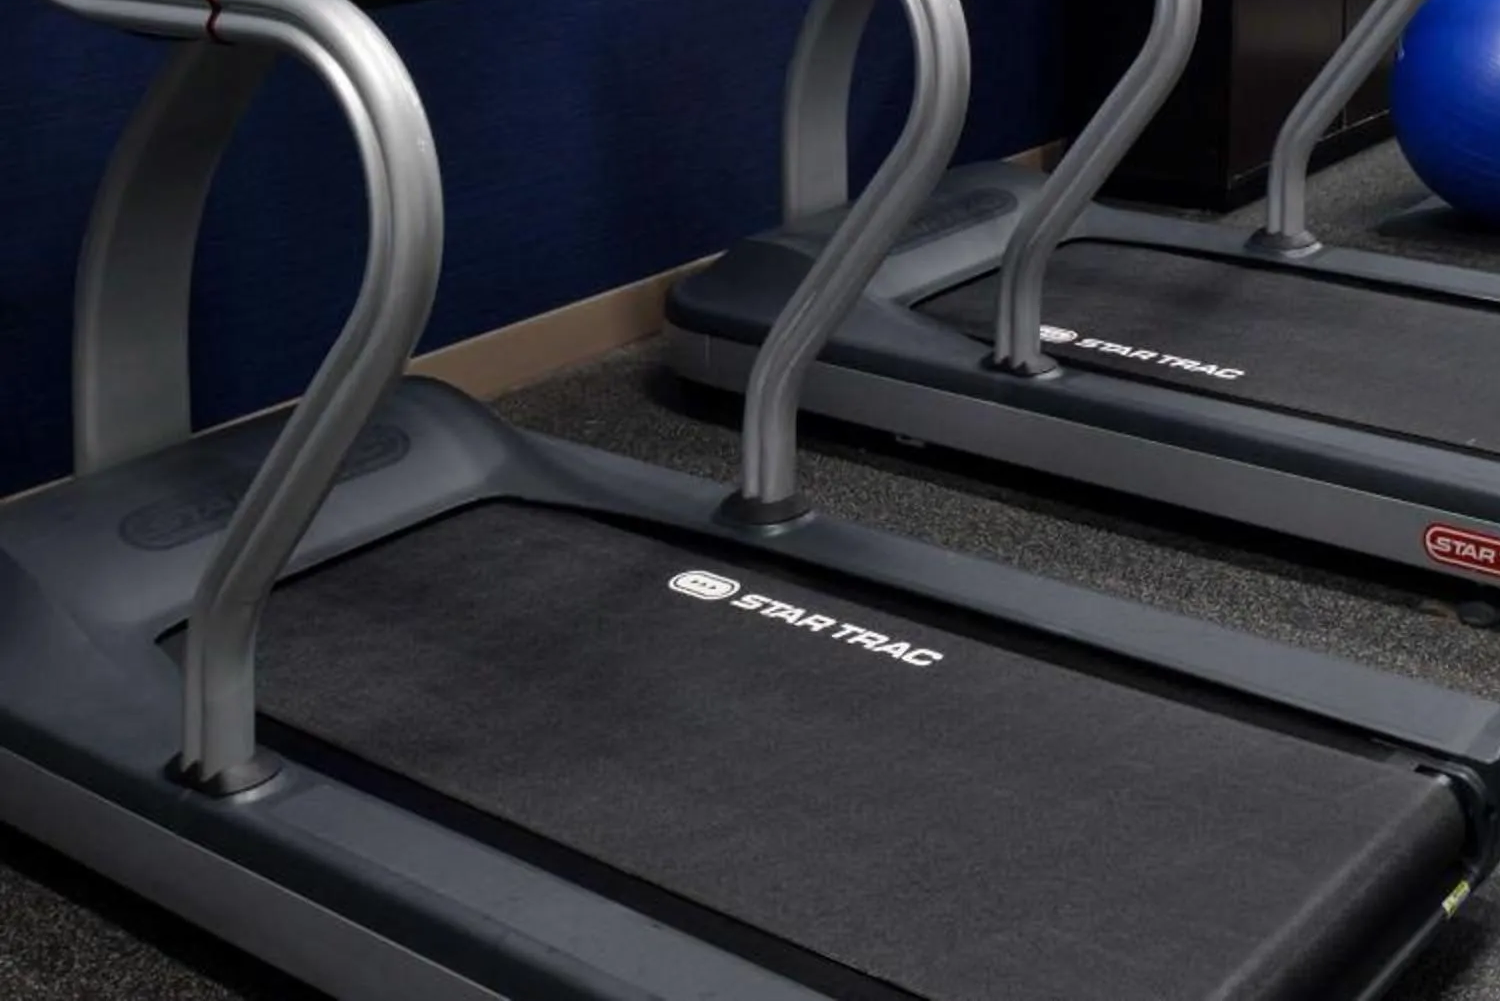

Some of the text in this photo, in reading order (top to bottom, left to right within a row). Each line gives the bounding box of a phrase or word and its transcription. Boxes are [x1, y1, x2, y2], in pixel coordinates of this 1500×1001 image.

[1075, 338, 1246, 380] STAR TRAC
[1434, 536, 1496, 564] STAR
[730, 594, 944, 666] STAR TRAC
